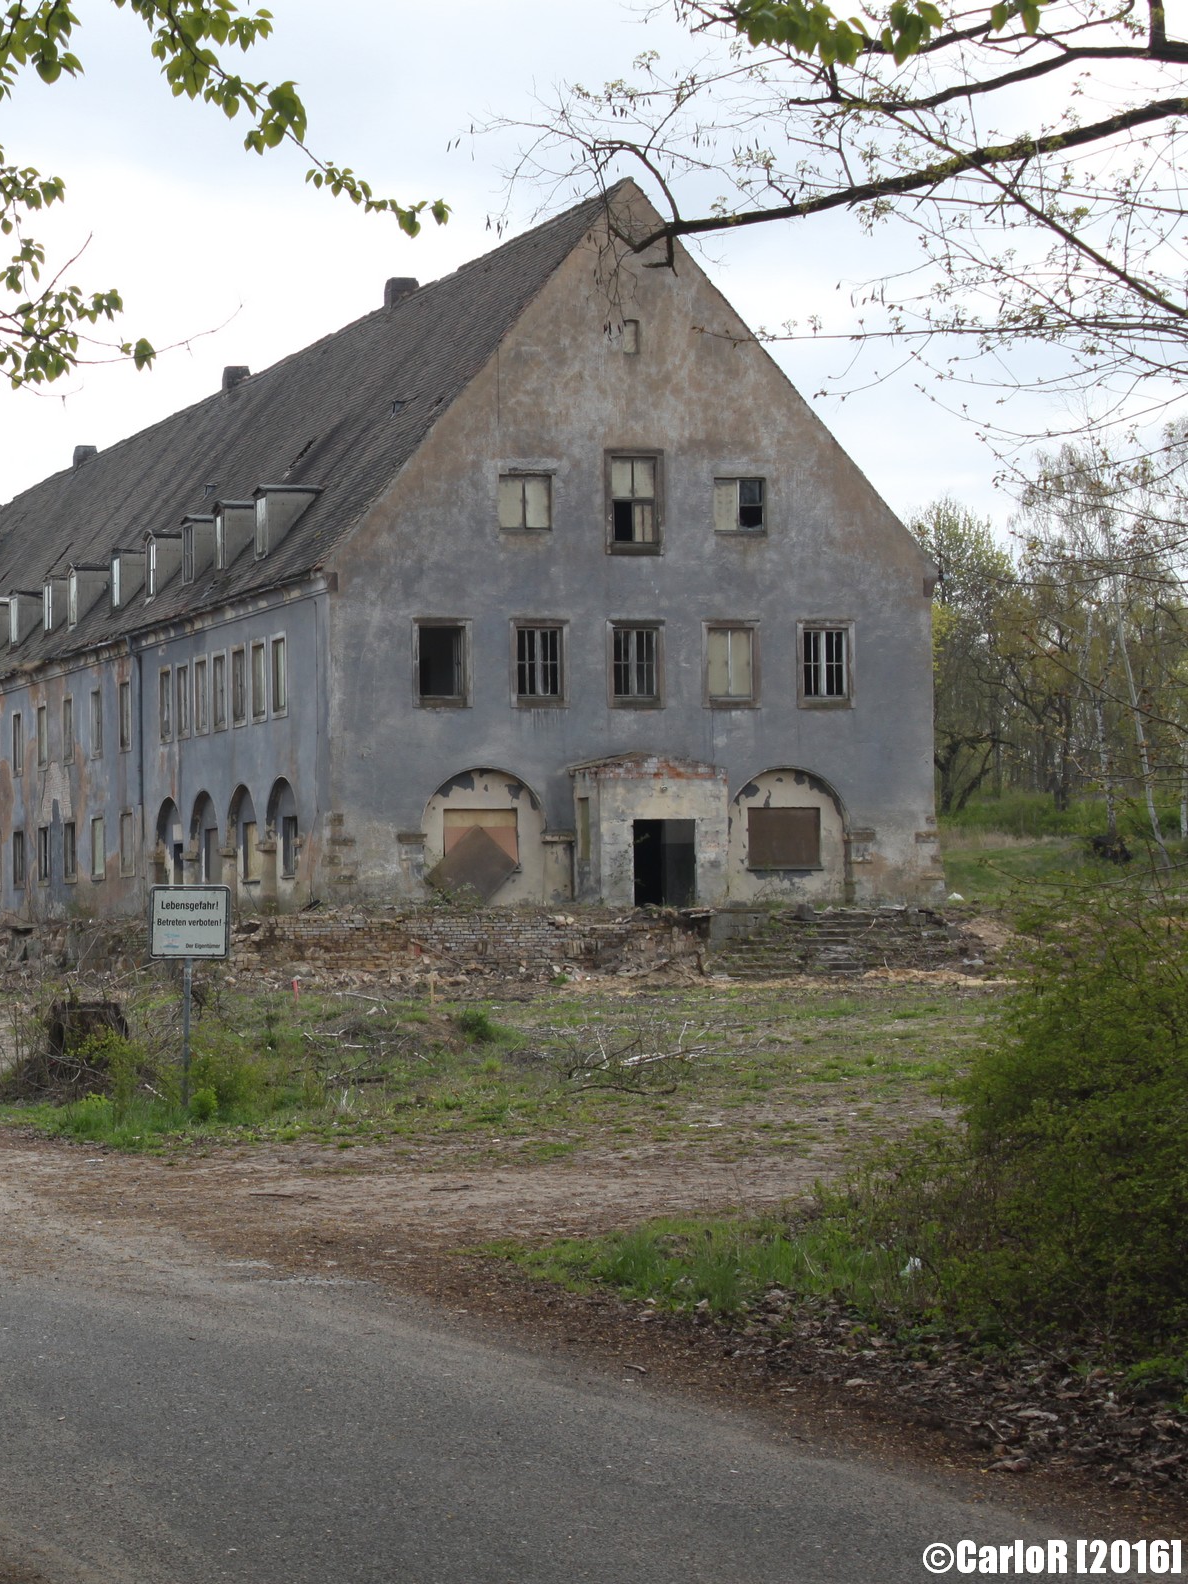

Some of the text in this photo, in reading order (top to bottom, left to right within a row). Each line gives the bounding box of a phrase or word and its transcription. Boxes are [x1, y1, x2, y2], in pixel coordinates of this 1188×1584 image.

[161, 900, 219, 912] Lebensgefahr!
[157, 918, 222, 927] Betreten verboten!
